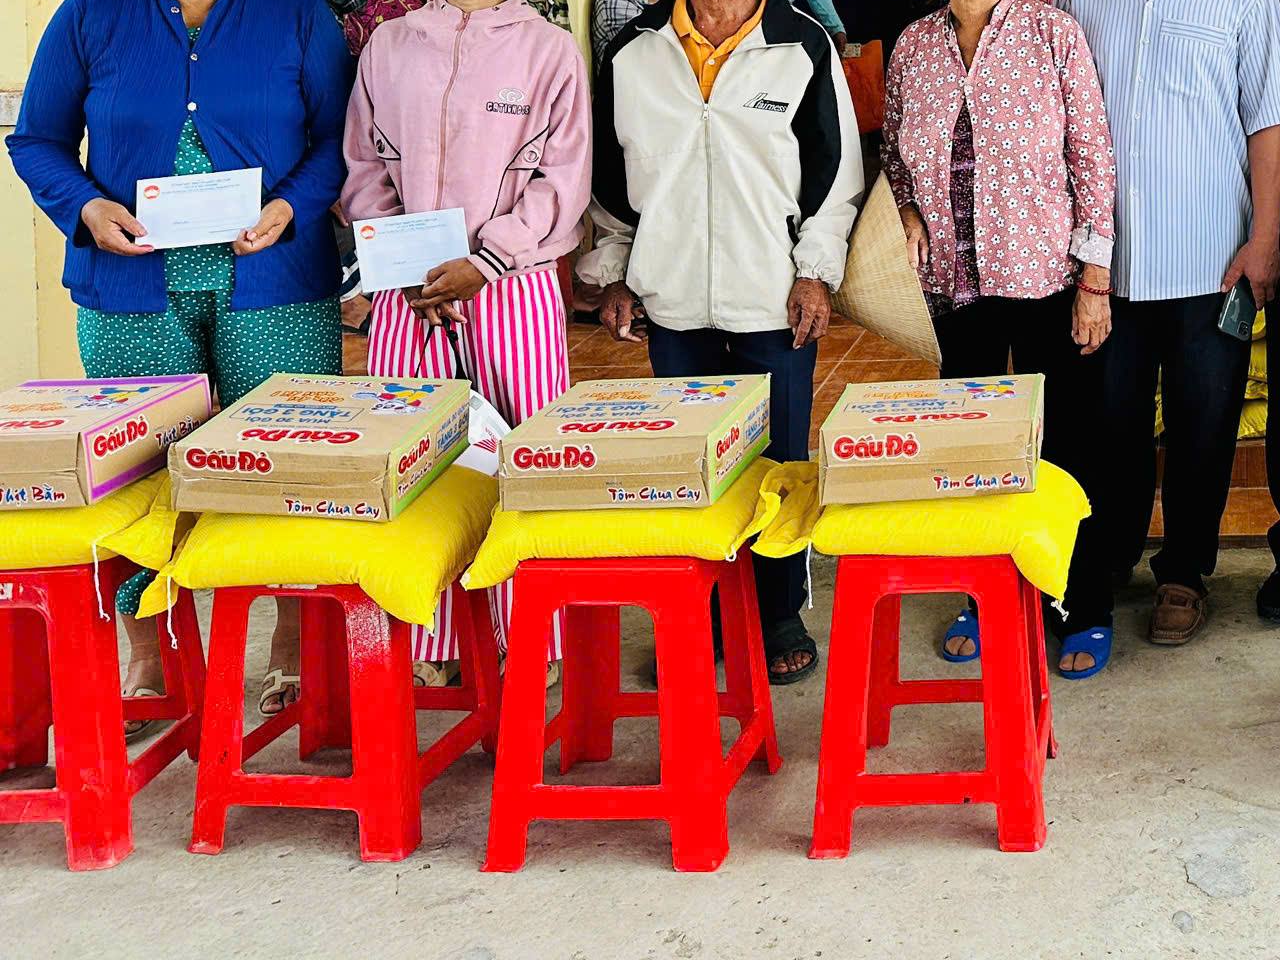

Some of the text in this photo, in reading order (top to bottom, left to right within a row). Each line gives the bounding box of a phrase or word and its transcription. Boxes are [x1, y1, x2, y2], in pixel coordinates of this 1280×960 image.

[94, 415, 148, 456] Gấu Đỏ
[834, 433, 918, 460] Gấu Đỏ
[186, 448, 272, 473] Gấu Đỏ
[513, 444, 596, 469] Gấu Đỏ
[31, 483, 65, 501] Bằm
[934, 472, 1026, 490] Tôm Chua Cay
[608, 486, 701, 502] Tôm Chua Cay
[285, 499, 380, 518] Tôm Chua Cay
